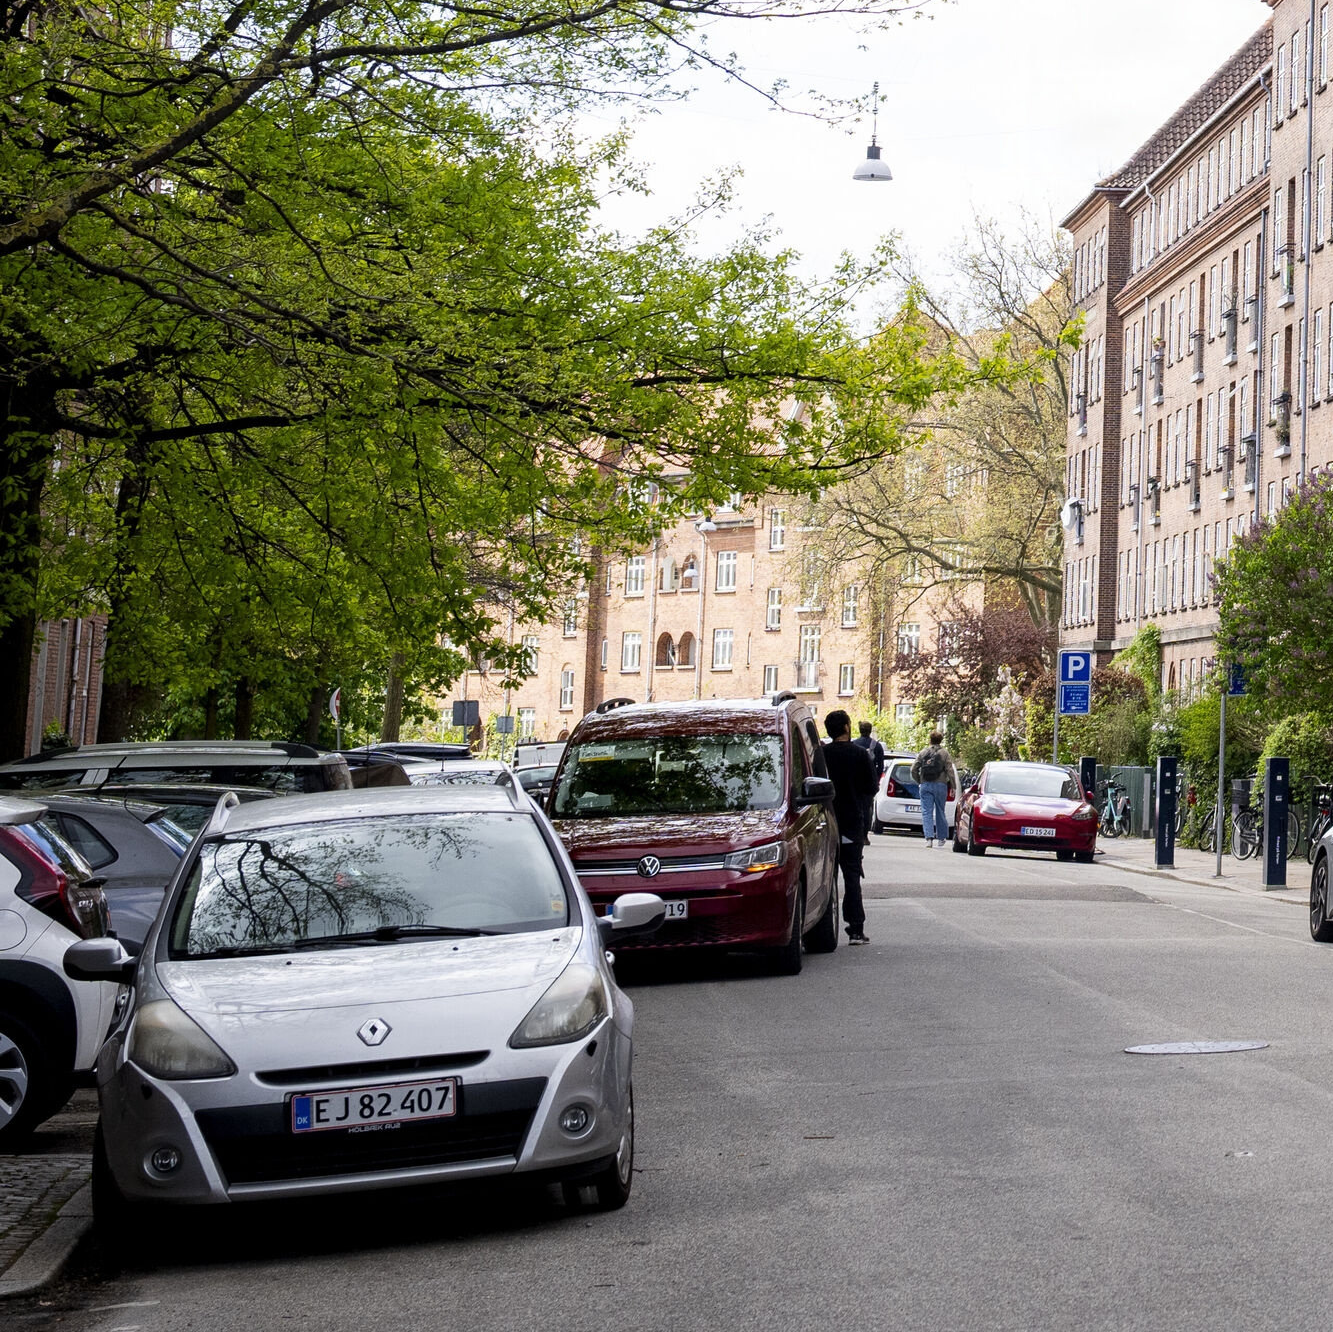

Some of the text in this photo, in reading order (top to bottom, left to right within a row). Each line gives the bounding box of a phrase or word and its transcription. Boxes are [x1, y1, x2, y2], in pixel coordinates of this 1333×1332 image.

[1068, 656, 1085, 679] P
[664, 902, 685, 916] 19
[315, 1086, 450, 1124] EJ 82 407
[297, 1116, 309, 1124] DK
